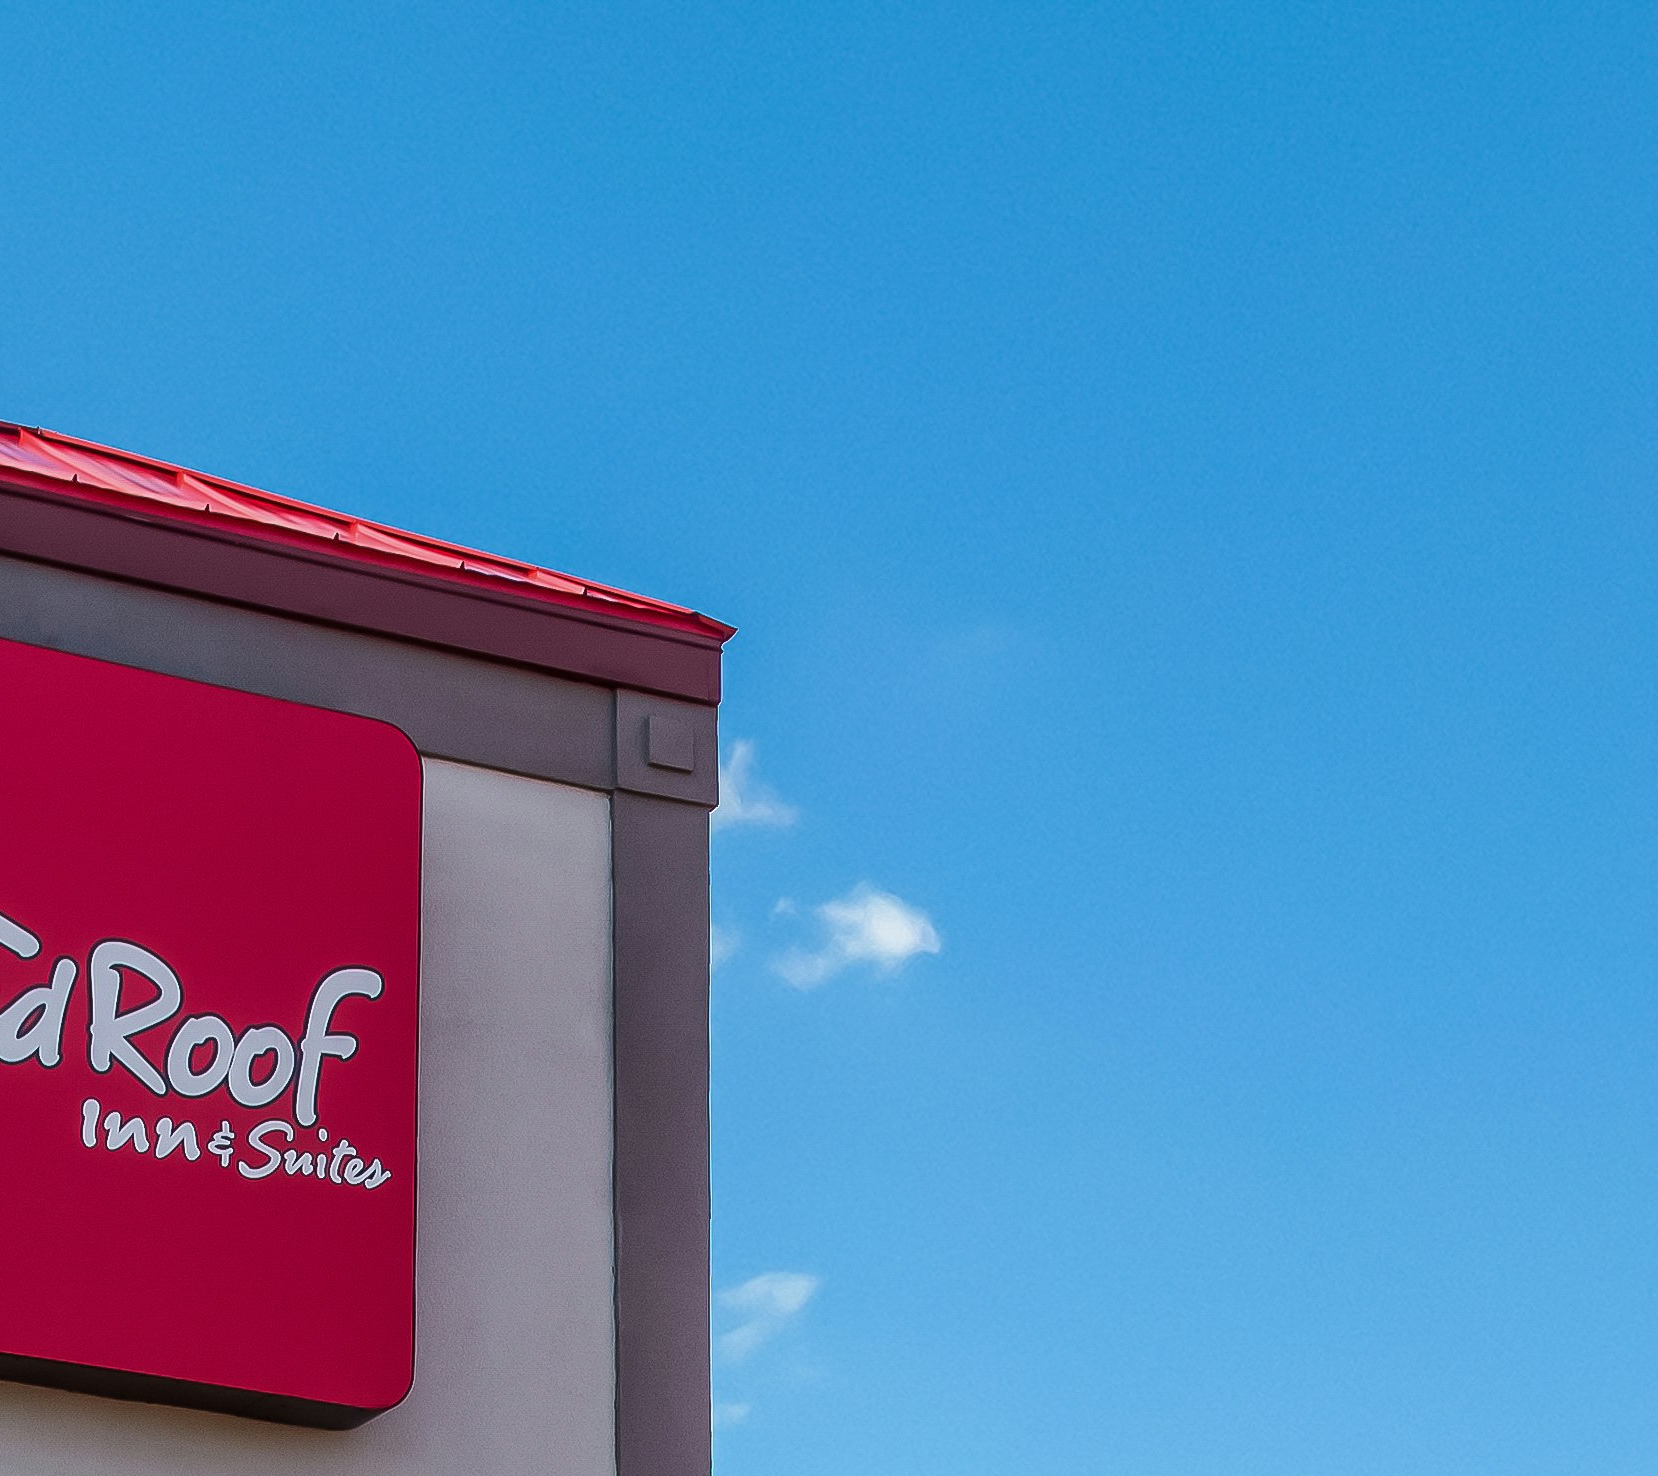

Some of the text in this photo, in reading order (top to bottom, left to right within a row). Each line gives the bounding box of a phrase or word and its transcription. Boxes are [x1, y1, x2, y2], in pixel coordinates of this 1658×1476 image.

[81, 1097, 393, 1190] Inn & Suites
